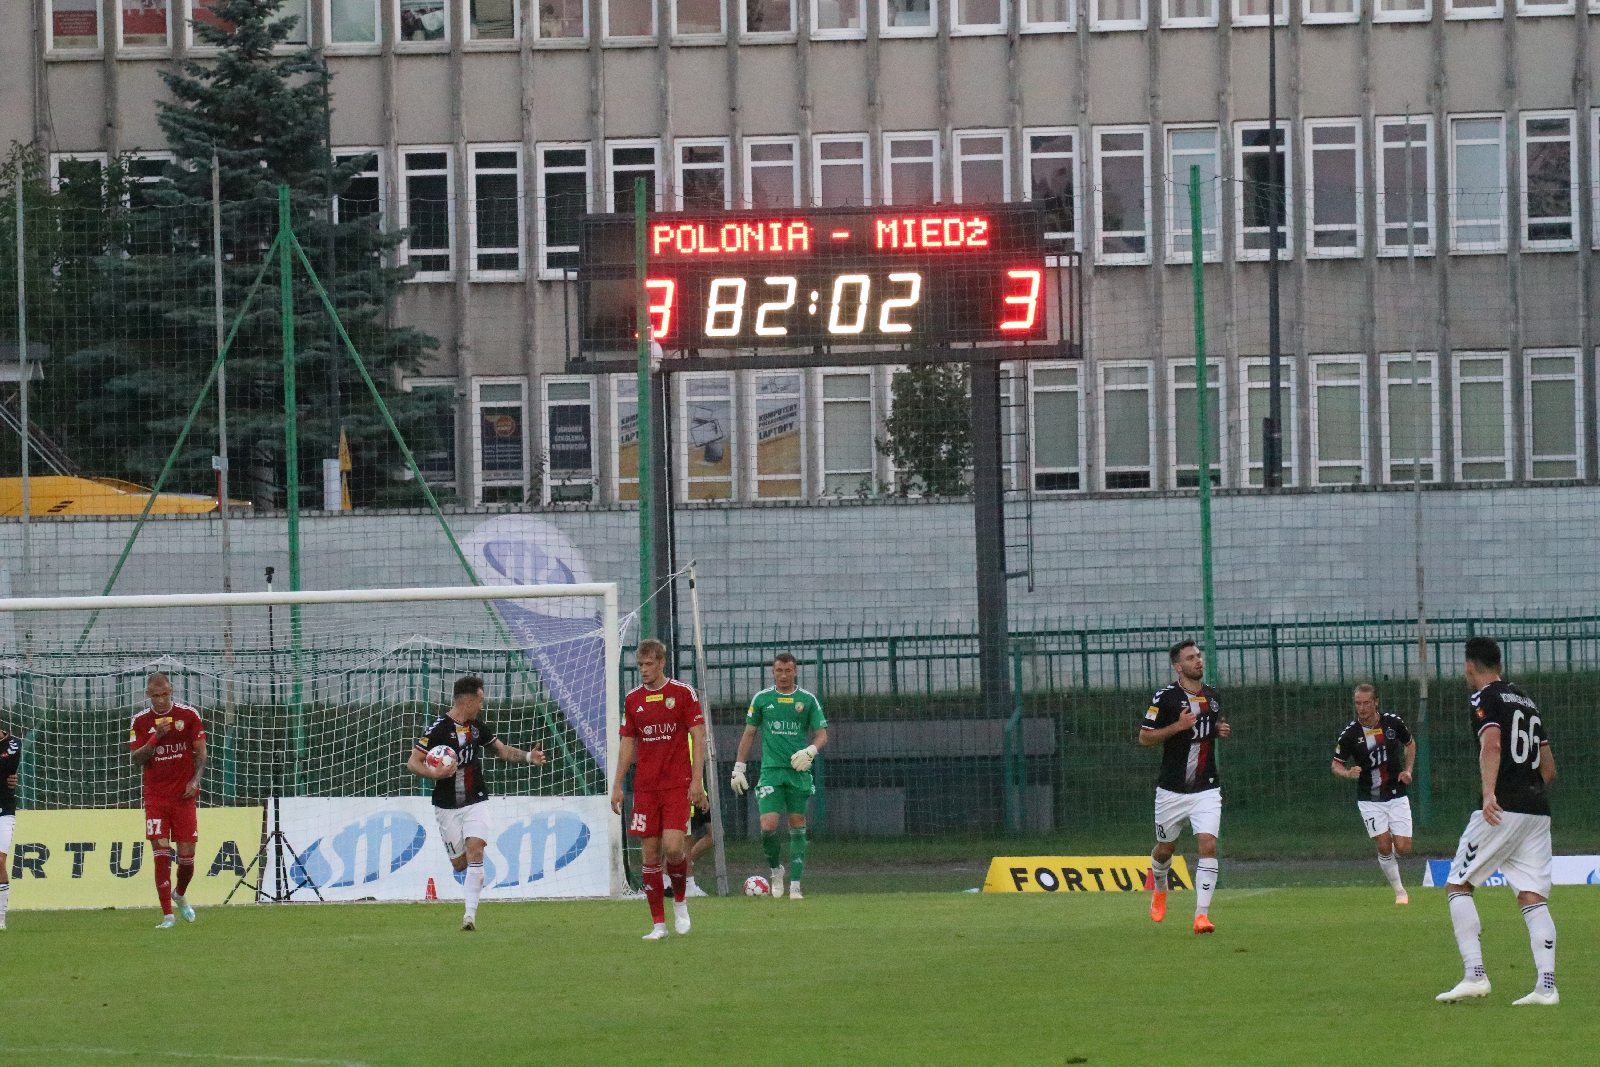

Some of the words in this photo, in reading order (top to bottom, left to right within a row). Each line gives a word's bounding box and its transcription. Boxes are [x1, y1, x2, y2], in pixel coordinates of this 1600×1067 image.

[653, 222, 809, 255] POLONIA
[637, 279, 675, 338] 3
[704, 272, 922, 337] 82:02
[1000, 270, 1041, 329] 3
[146, 818, 162, 835] 87
[11, 841, 247, 880] RTUA
